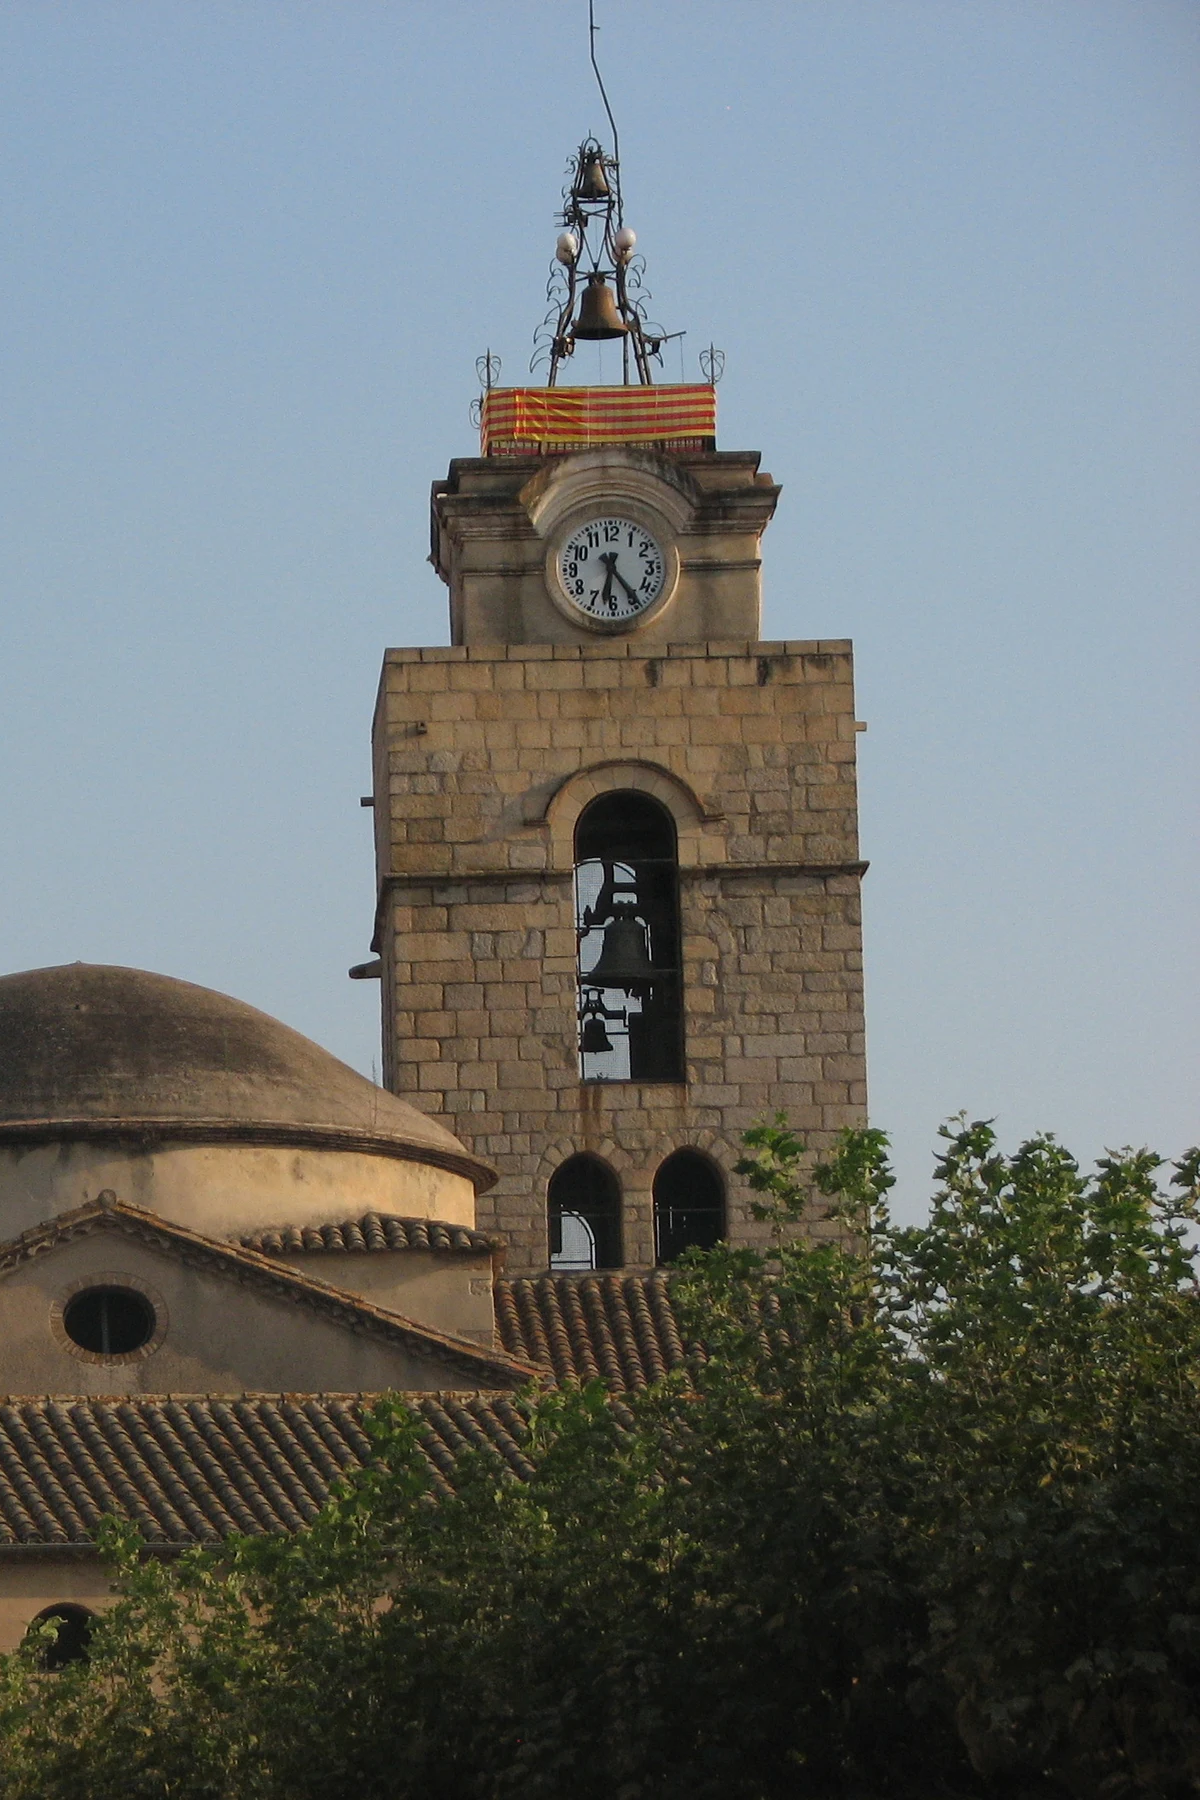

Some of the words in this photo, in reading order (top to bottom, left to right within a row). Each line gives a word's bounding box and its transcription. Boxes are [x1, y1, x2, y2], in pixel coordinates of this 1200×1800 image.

[587, 531, 599, 548] 11
[603, 526, 620, 542] 12
[628, 531, 633, 547] 1
[574, 545, 588, 561] 10
[638, 542, 649, 558] 2
[569, 562, 578, 578] 9
[645, 560, 655, 576] 3
[575, 579, 584, 595] 8
[639, 577, 652, 593] 4
[590, 590, 599, 606] 7
[608, 595, 617, 611] 6
